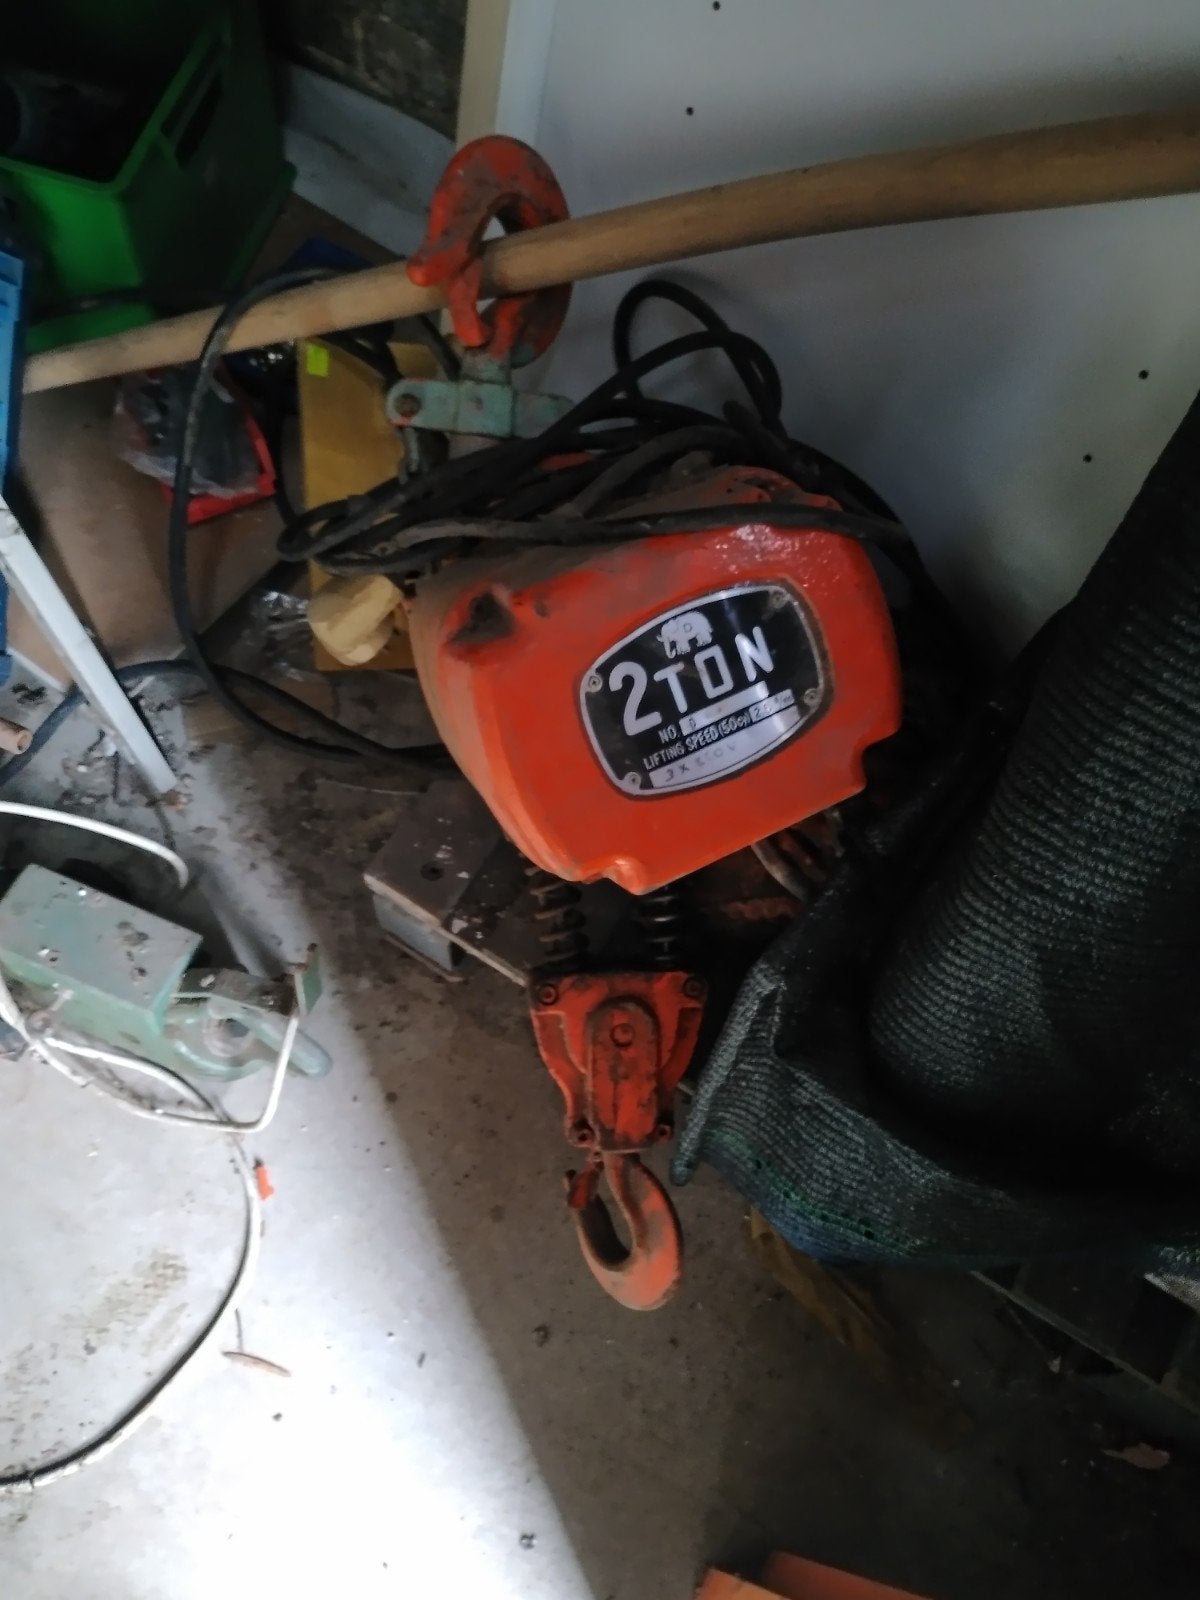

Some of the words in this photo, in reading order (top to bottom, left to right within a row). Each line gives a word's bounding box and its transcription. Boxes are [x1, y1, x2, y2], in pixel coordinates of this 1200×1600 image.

[609, 661, 662, 736] 2
[653, 626, 774, 714] TON
[642, 741, 685, 770] LIFTING
[685, 724, 719, 751] SPEED
